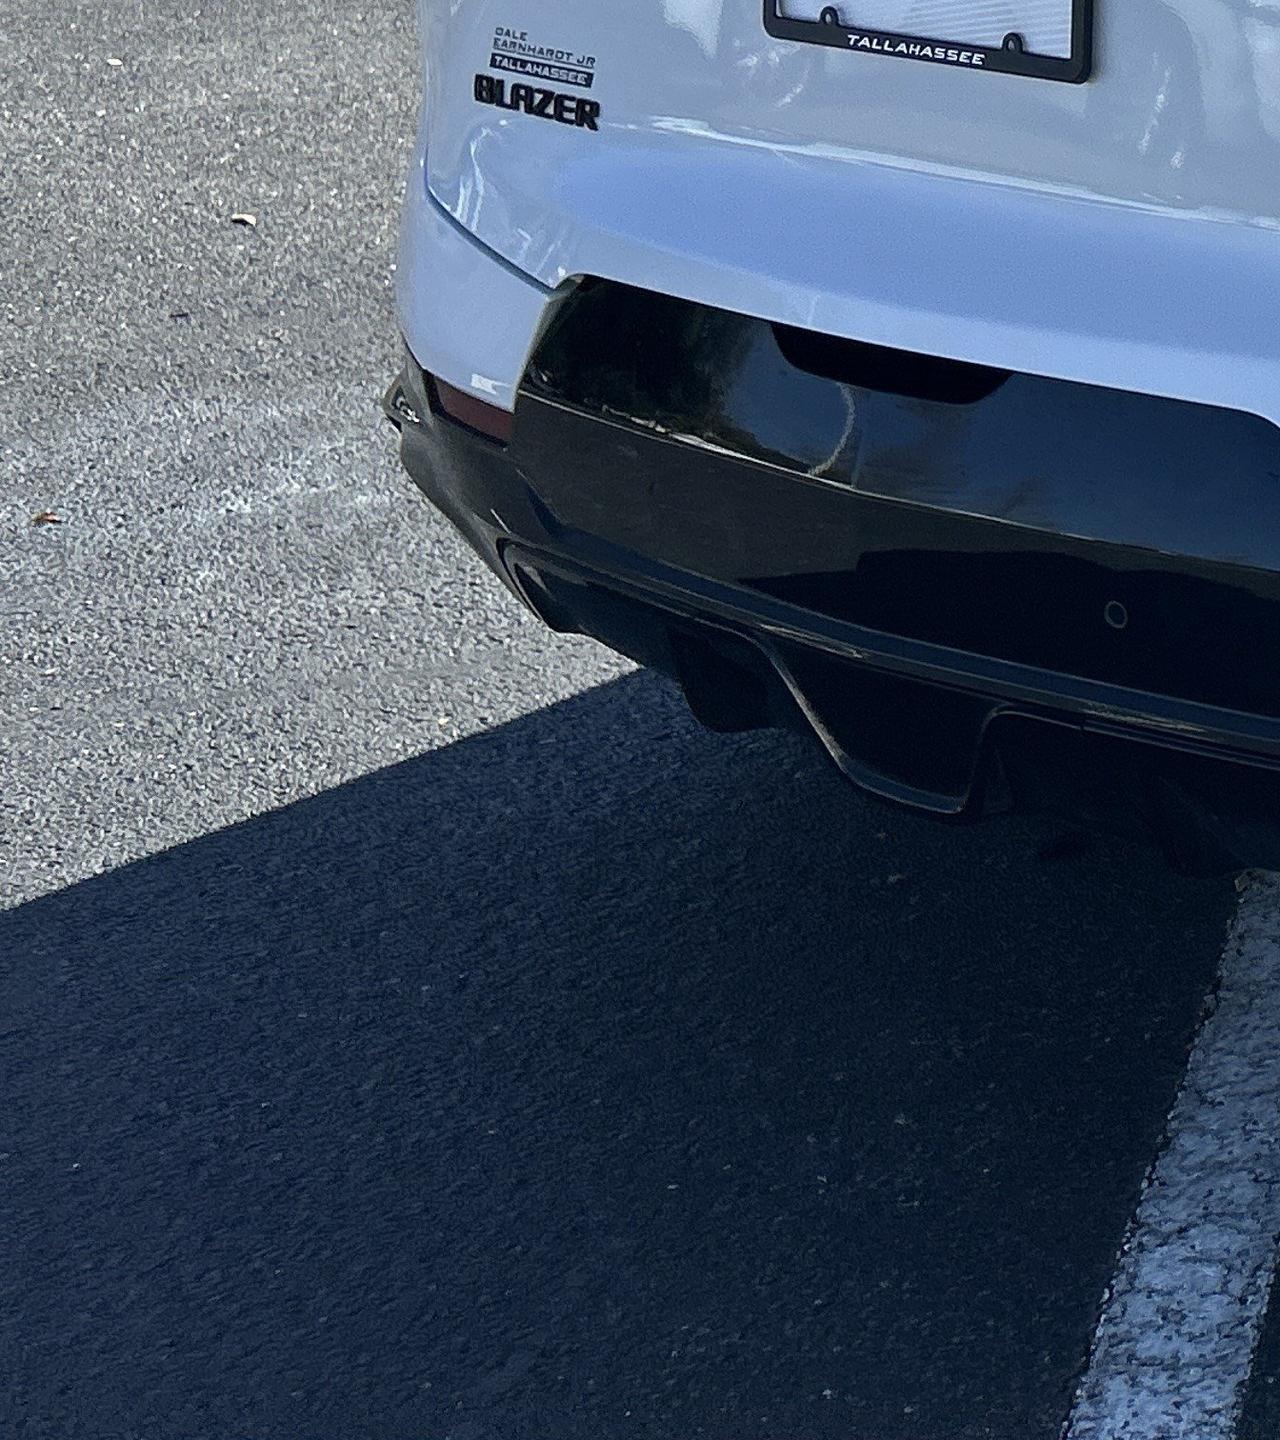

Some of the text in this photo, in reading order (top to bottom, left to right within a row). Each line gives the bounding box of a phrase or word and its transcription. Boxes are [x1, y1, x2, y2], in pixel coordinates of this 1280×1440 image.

[494, 26, 528, 42] DALE
[492, 37, 597, 68] EARNHARDT JR
[847, 34, 986, 67] TALLAHASSEE
[494, 56, 589, 85] TALLAHASSEE
[474, 73, 601, 132] BLAZER
